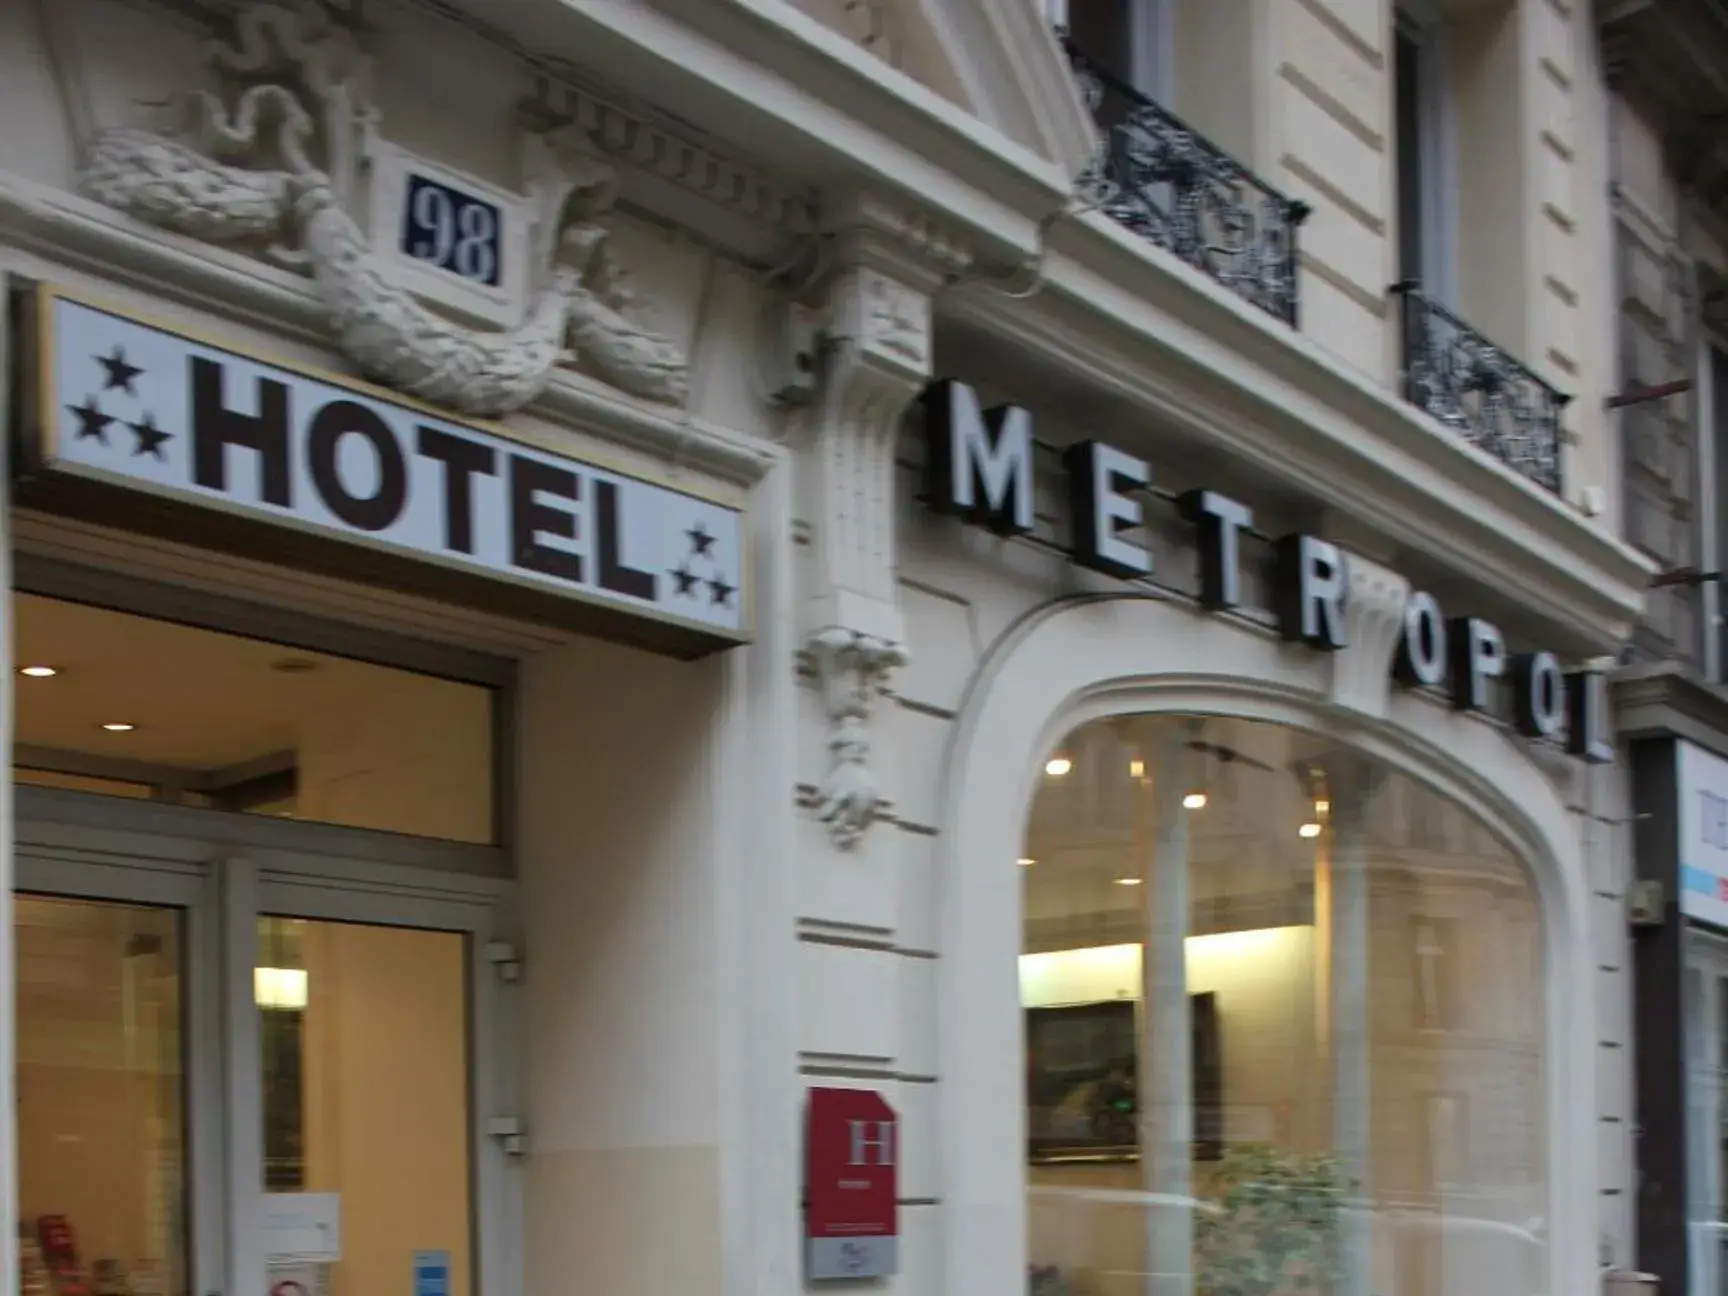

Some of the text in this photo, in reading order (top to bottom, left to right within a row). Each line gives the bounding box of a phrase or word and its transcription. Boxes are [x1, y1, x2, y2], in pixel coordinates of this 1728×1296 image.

[413, 186, 495, 284] 98
[186, 353, 658, 602] HOTEL
[944, 378, 1614, 764] METROPOL
[847, 1119, 898, 1166] H
